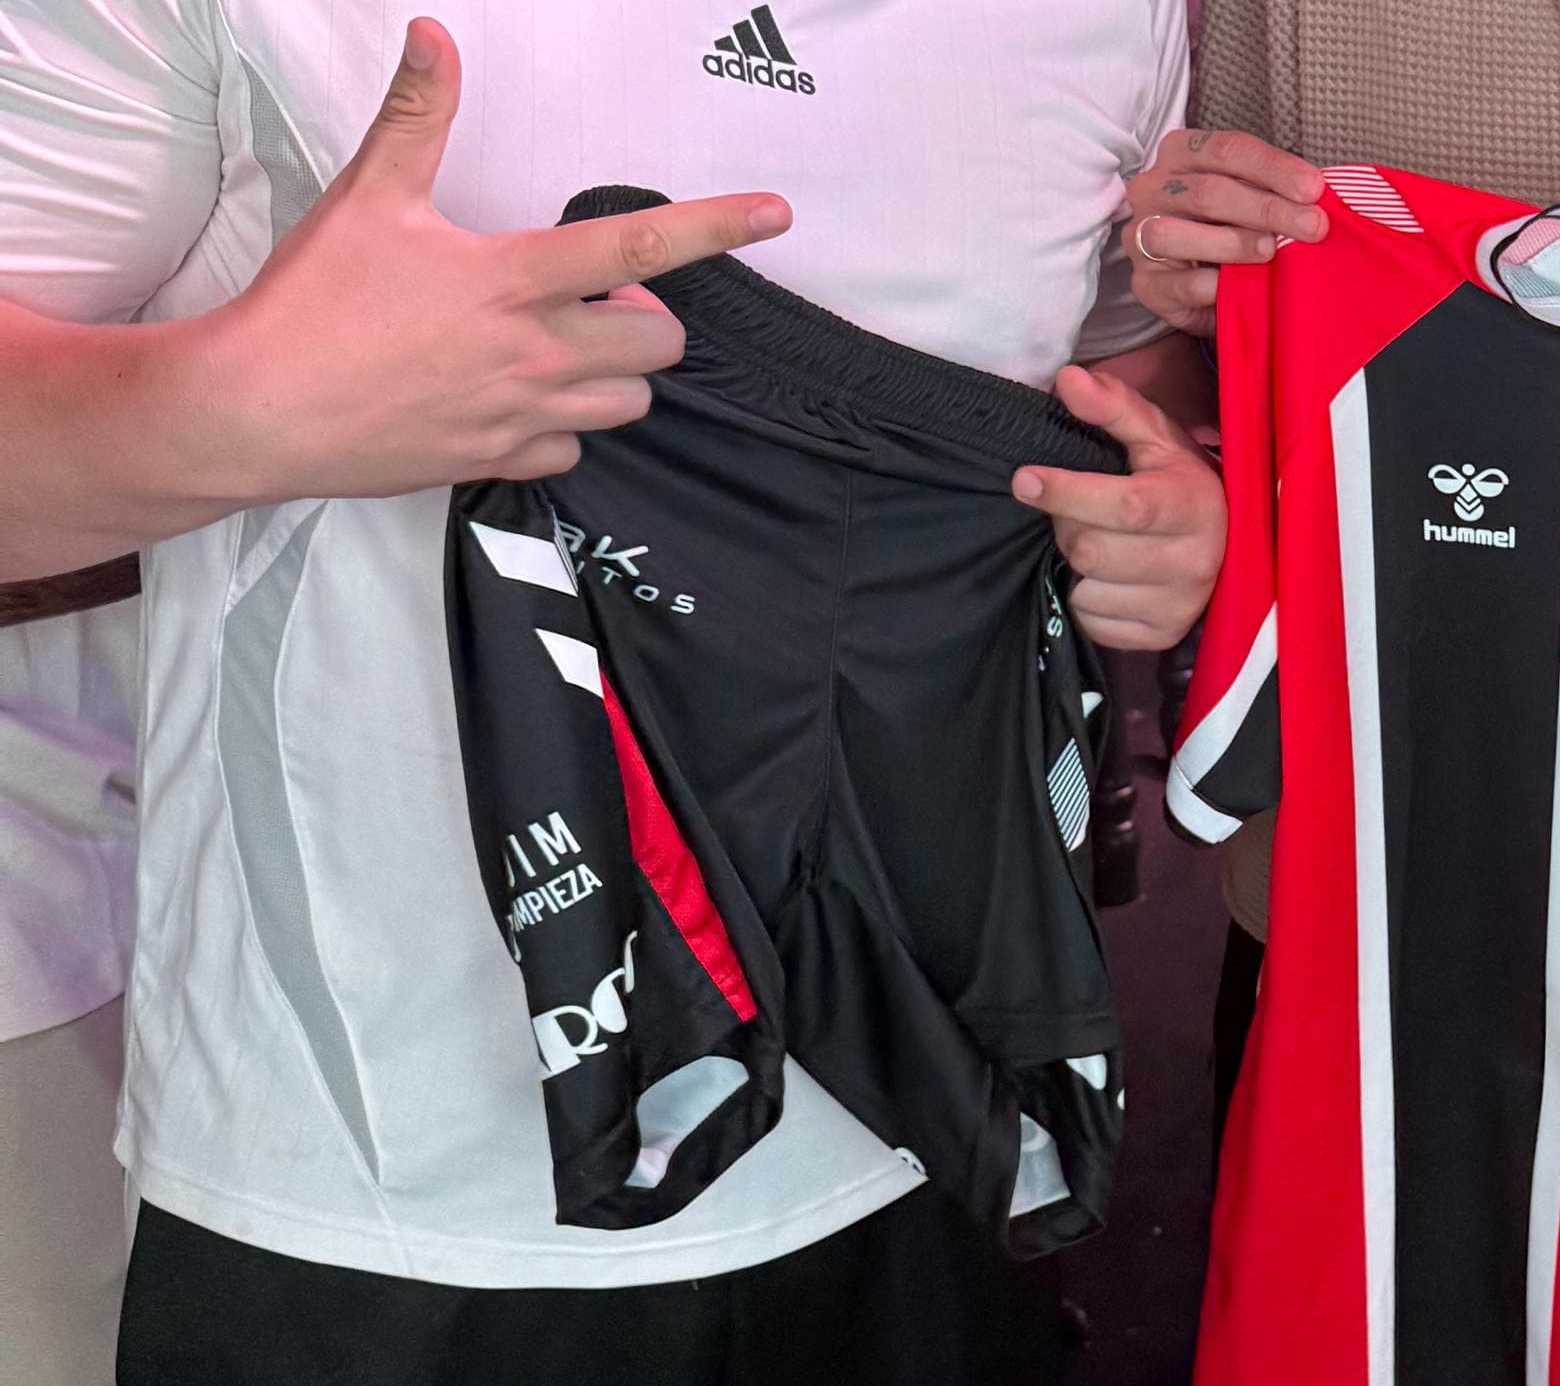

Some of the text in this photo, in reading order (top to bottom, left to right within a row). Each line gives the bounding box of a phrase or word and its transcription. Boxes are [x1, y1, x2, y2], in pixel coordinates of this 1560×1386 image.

[702, 53, 817, 96] adidas
[1423, 518, 1517, 549] hummel
[502, 811, 583, 888] IM
